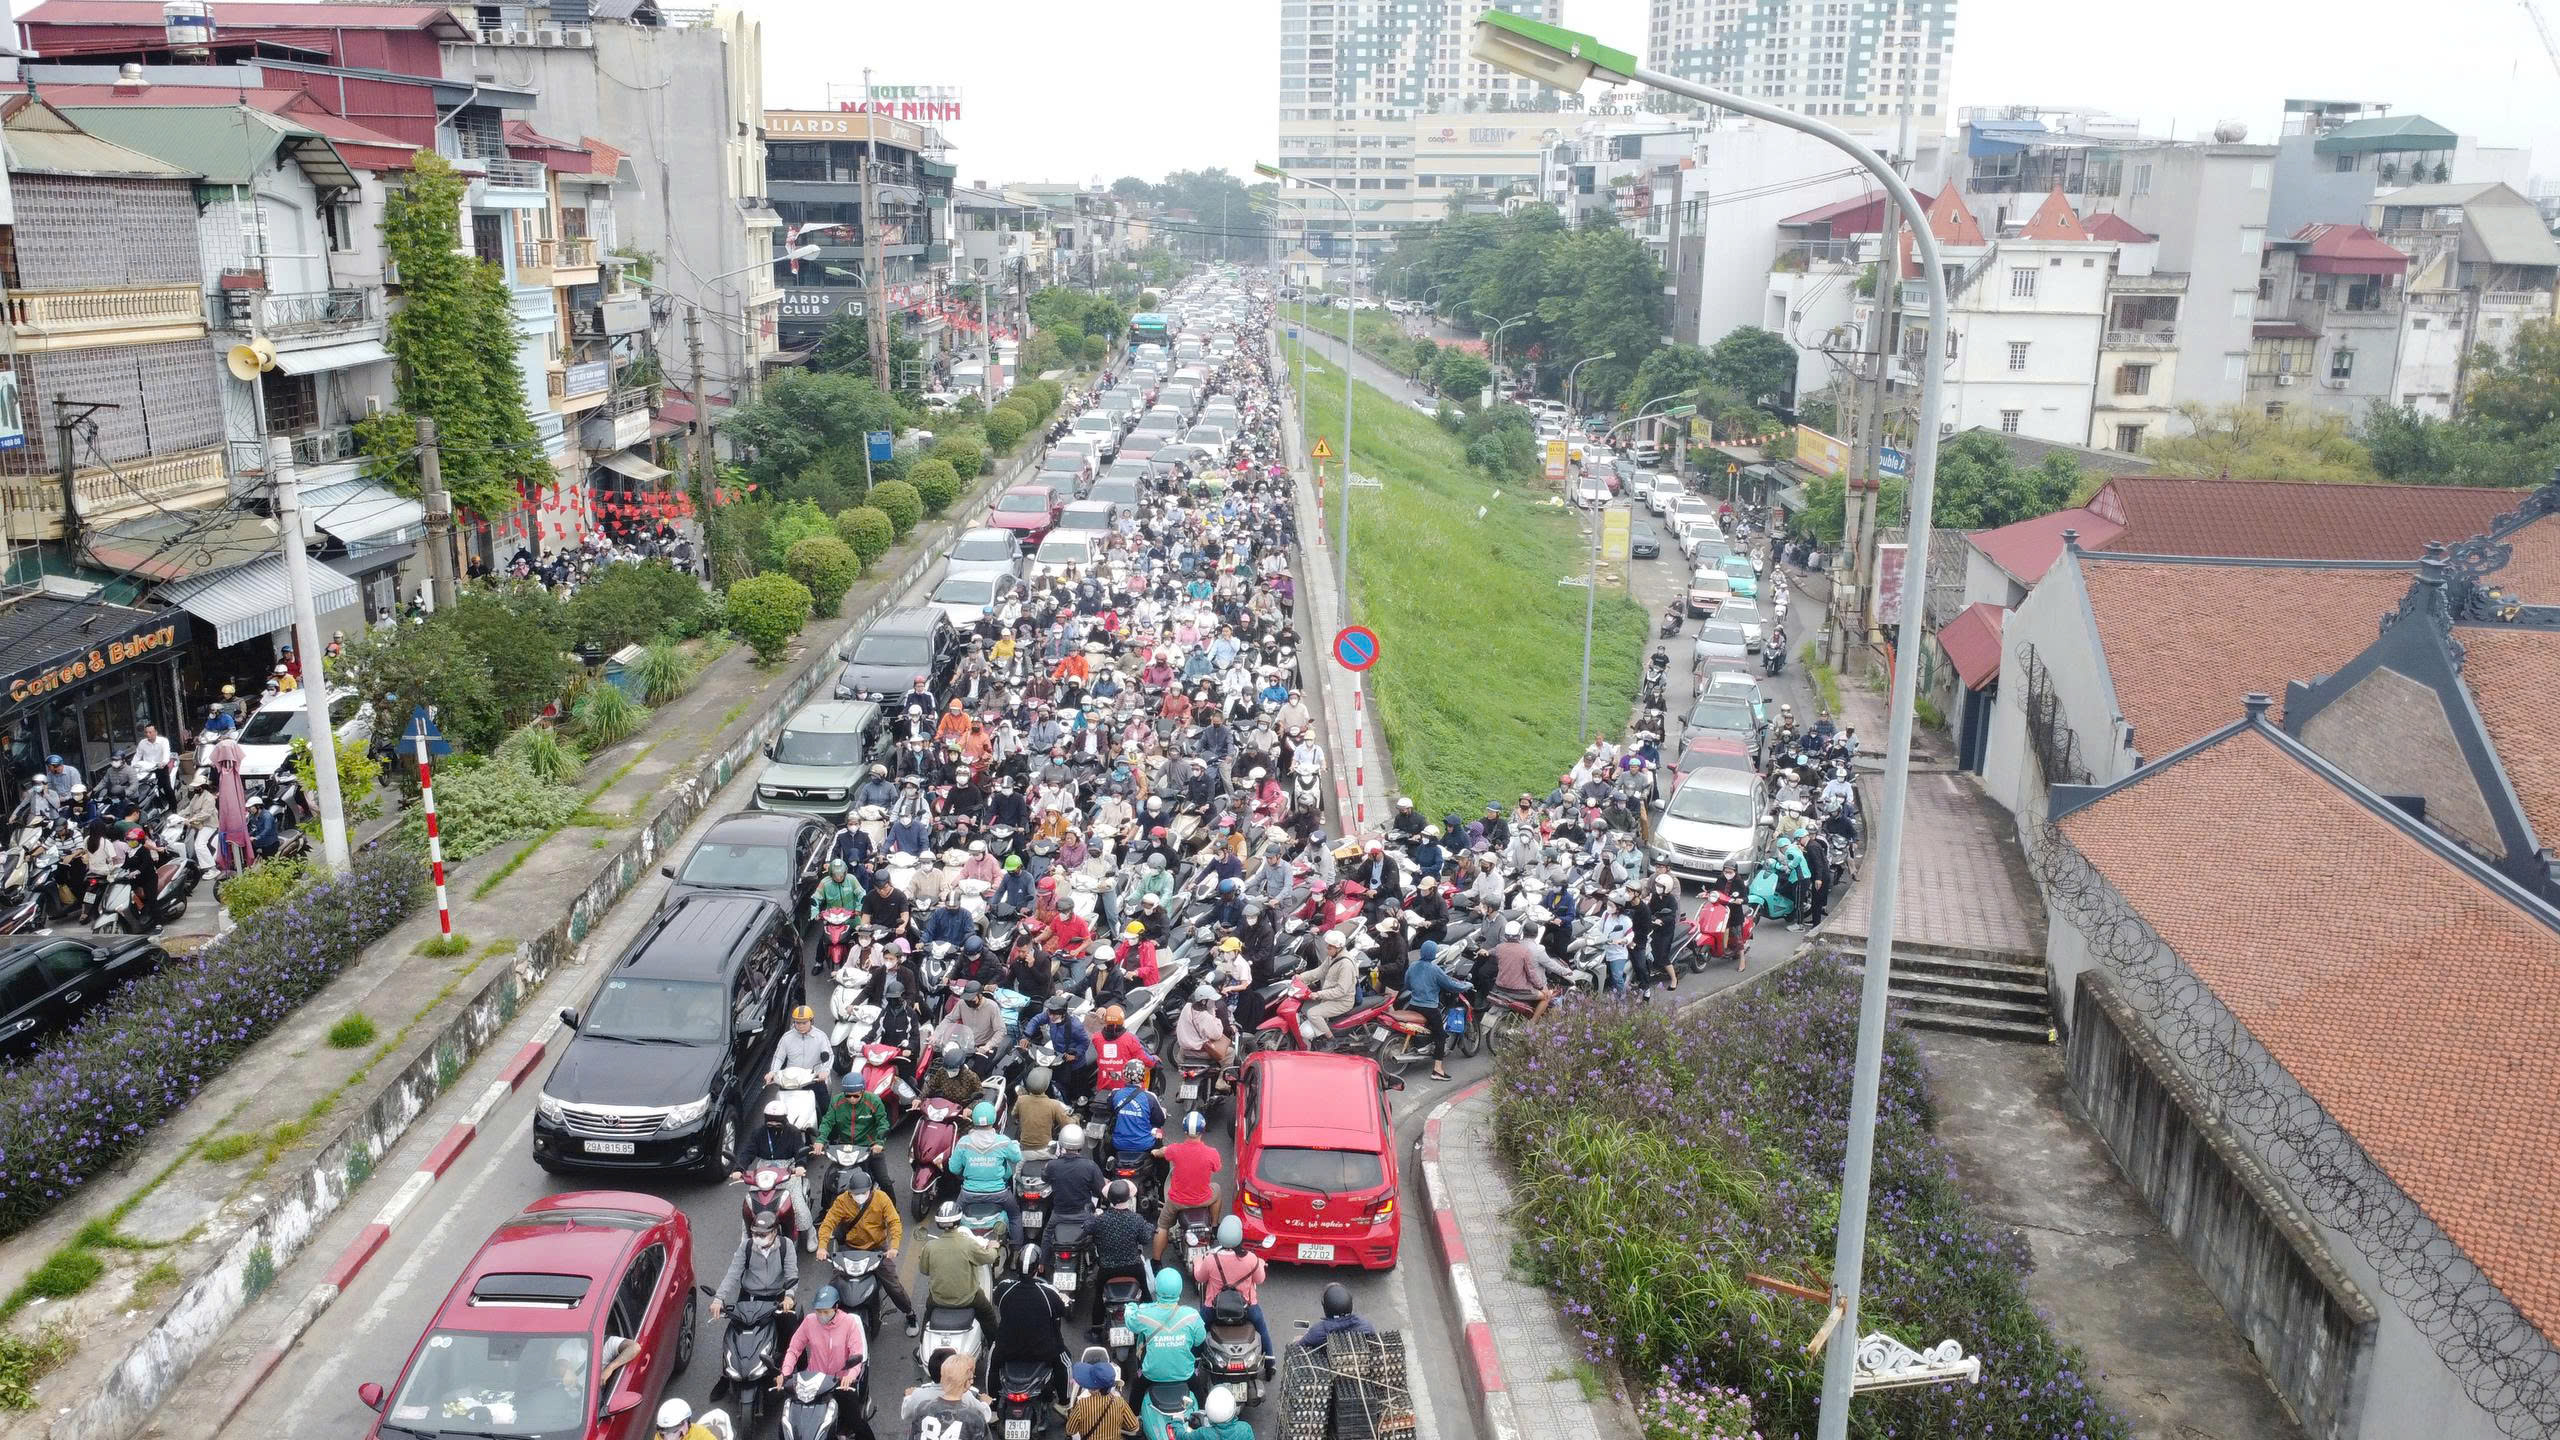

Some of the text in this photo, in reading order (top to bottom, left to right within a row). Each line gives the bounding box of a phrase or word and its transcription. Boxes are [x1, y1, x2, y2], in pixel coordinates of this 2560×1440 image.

[870, 86, 919, 98] HOTEL
[902, 102, 960, 121] NINH
[783, 305, 820, 315] CLUB
[88, 650, 106, 672] &
[108, 625, 175, 665] Bakery
[1302, 1251, 1330, 1259] 227.02
